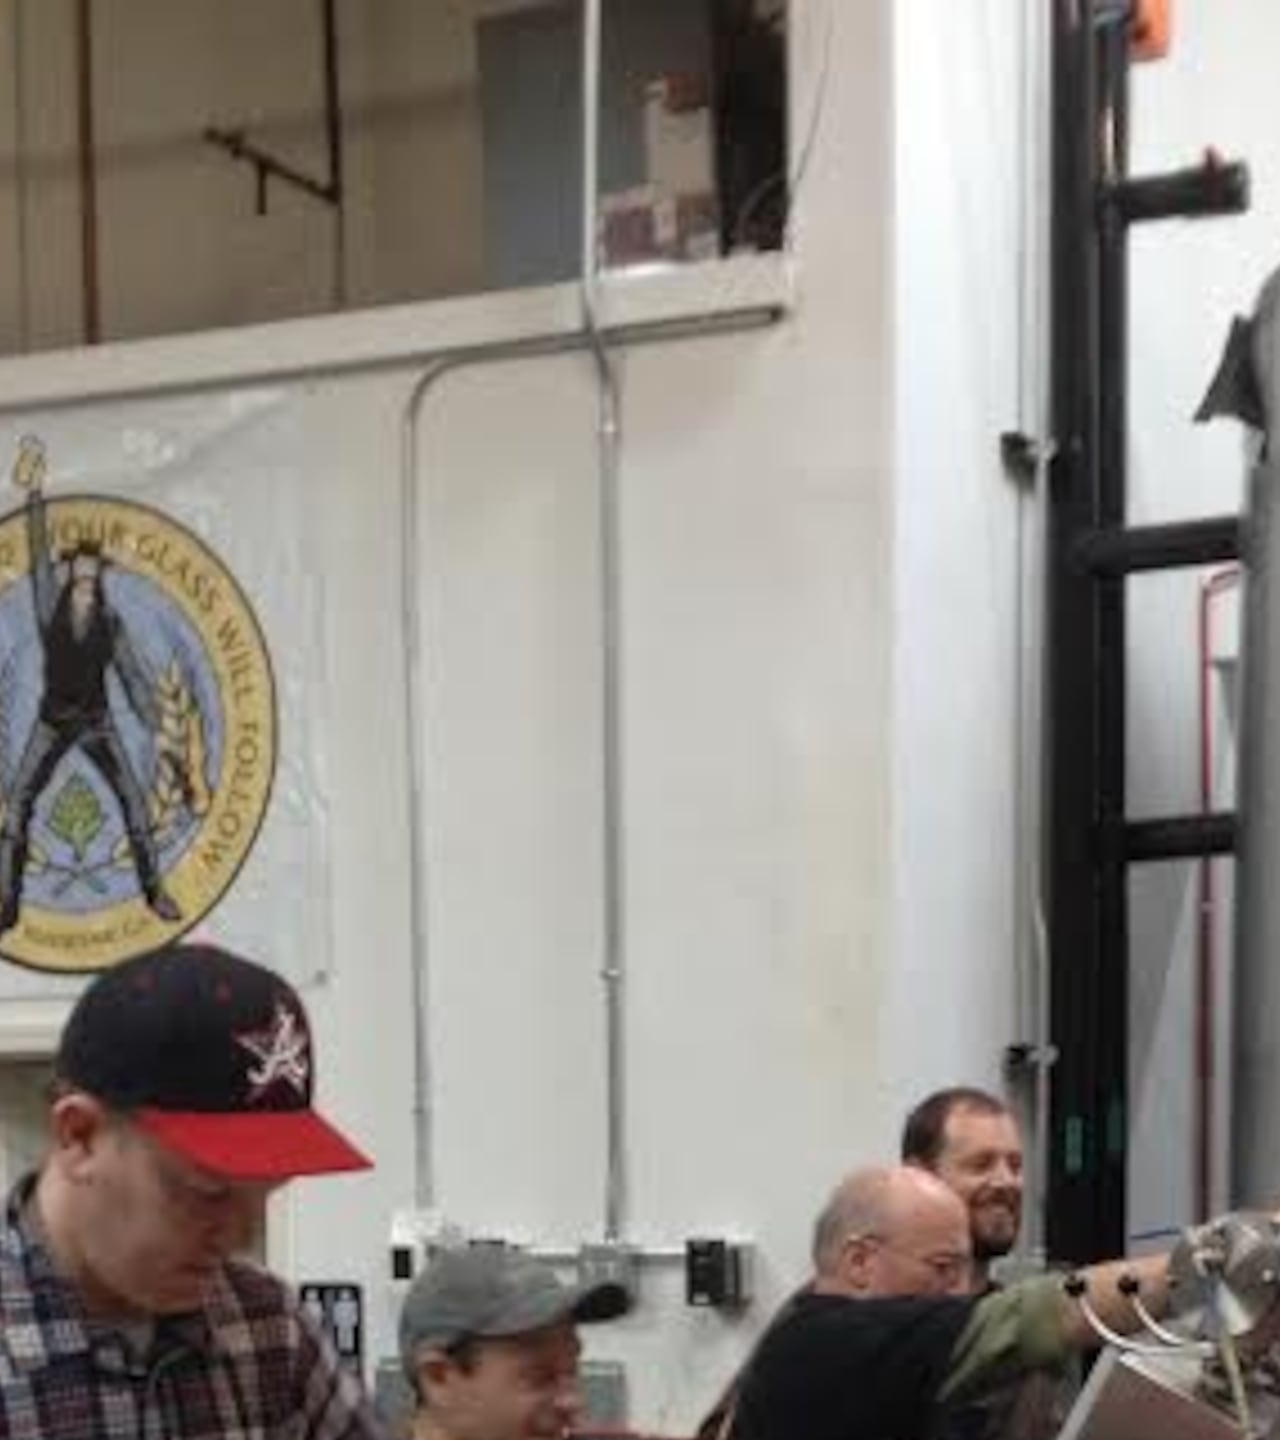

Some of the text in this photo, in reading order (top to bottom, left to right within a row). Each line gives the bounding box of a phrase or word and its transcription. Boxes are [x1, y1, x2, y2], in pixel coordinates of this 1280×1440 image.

[136, 533, 219, 613] GLASS
[217, 617, 256, 709] WILL
[202, 721, 261, 876] FOLLOW
